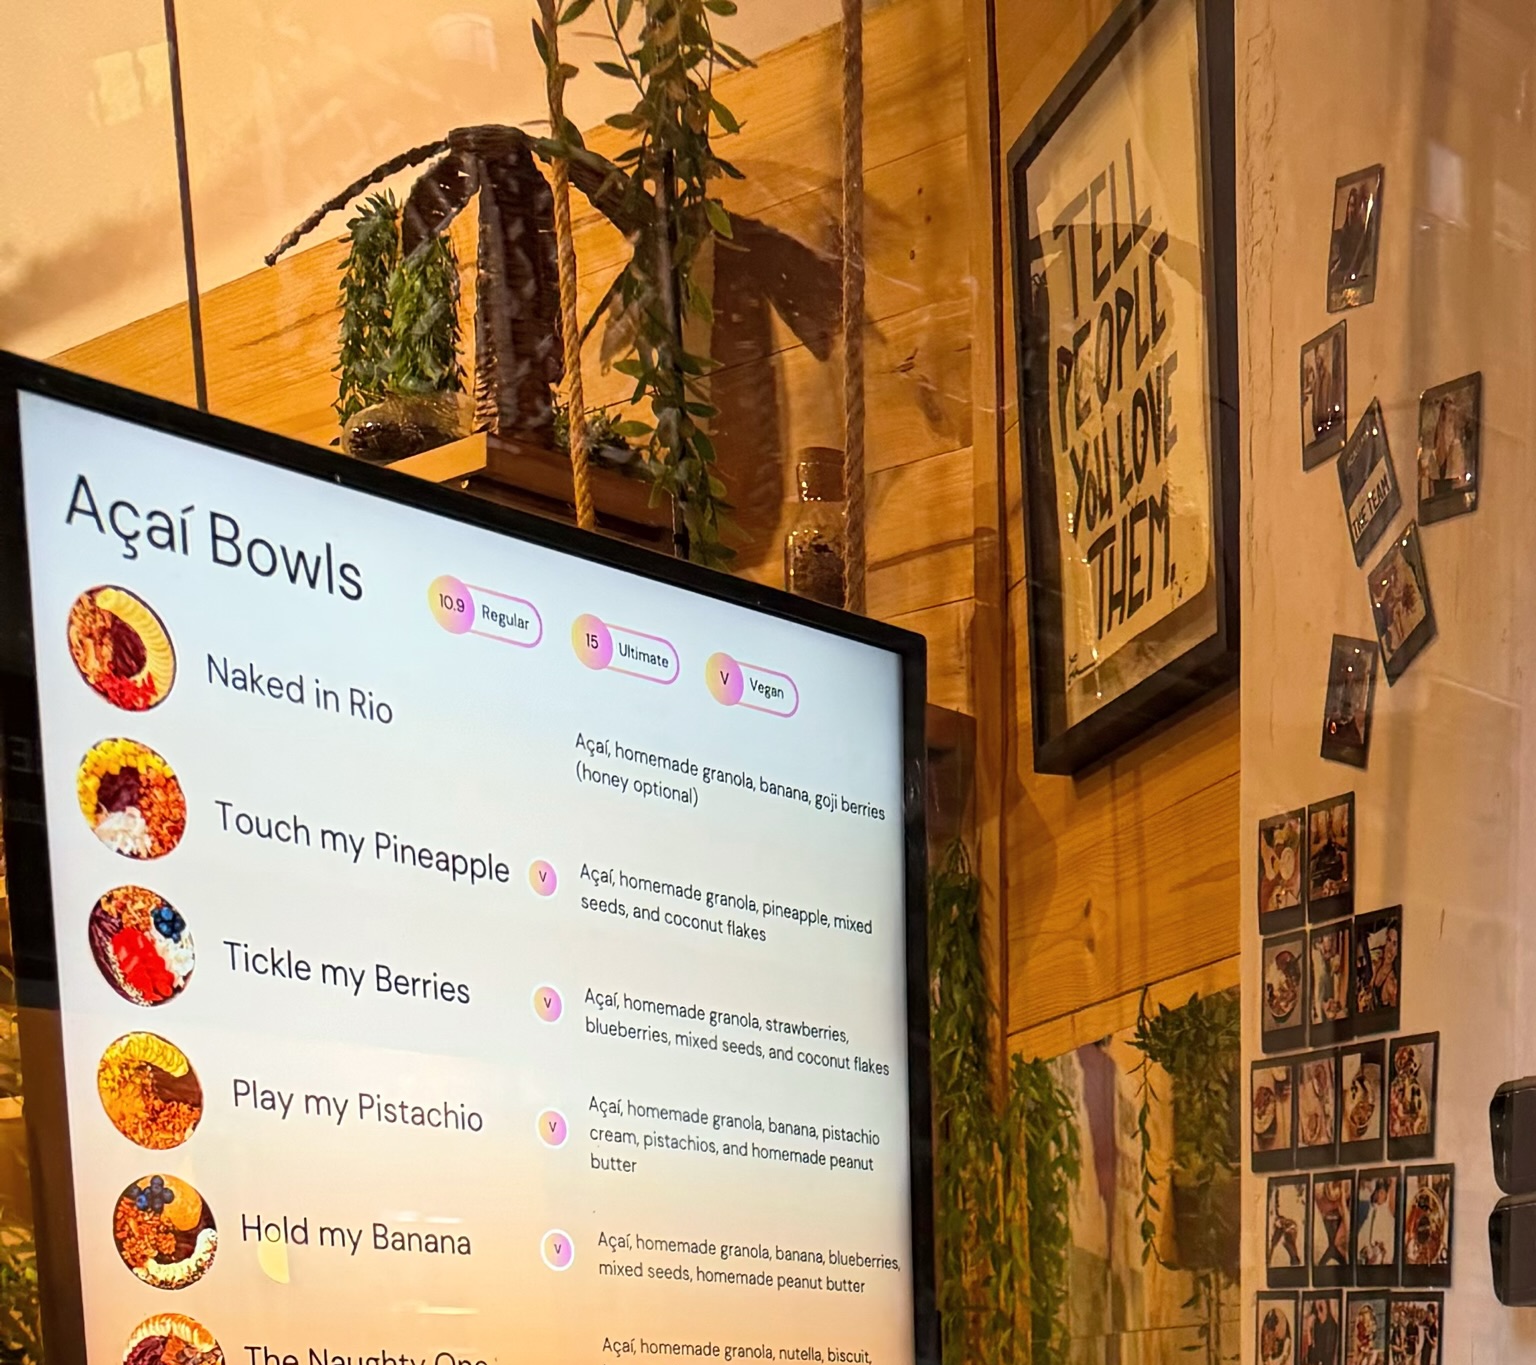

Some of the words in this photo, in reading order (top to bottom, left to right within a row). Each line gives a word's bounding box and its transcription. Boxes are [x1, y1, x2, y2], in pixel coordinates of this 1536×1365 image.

[1053, 138, 1152, 319] TELL
[1057, 228, 1168, 453] PEOPLE
[1117, 351, 1178, 503] LOVE
[65, 474, 195, 560] Açaí
[209, 511, 363, 601] Bowls
[1087, 480, 1176, 640] THEM.
[482, 604, 530, 630] Regular
[586, 632, 599, 650] 15
[207, 653, 305, 705] Naked
[315, 678, 340, 713] in
[349, 687, 393, 724] Rio
[618, 642, 669, 669] Ultimate
[749, 677, 784, 699] Vegan
[575, 732, 611, 758] Açaí,
[615, 741, 699, 777] homemade
[702, 766, 756, 792] granola,
[759, 776, 812, 806] banana,
[814, 793, 838, 813] goji
[841, 795, 886, 821] berries
[576, 760, 629, 793] (honey
[633, 779, 699, 808] optional)
[214, 800, 310, 846] Touch
[321, 829, 365, 864] my
[375, 831, 510, 885] Pineapple
[223, 940, 311, 981] Tickle
[321, 963, 366, 997] my
[375, 963, 470, 1004] Berries
[233, 1078, 294, 1120] Play
[304, 1094, 349, 1126] my
[358, 1092, 483, 1132] Pistachio
[242, 1213, 309, 1245] Hold
[319, 1226, 363, 1256] my
[372, 1222, 471, 1256] Banana
